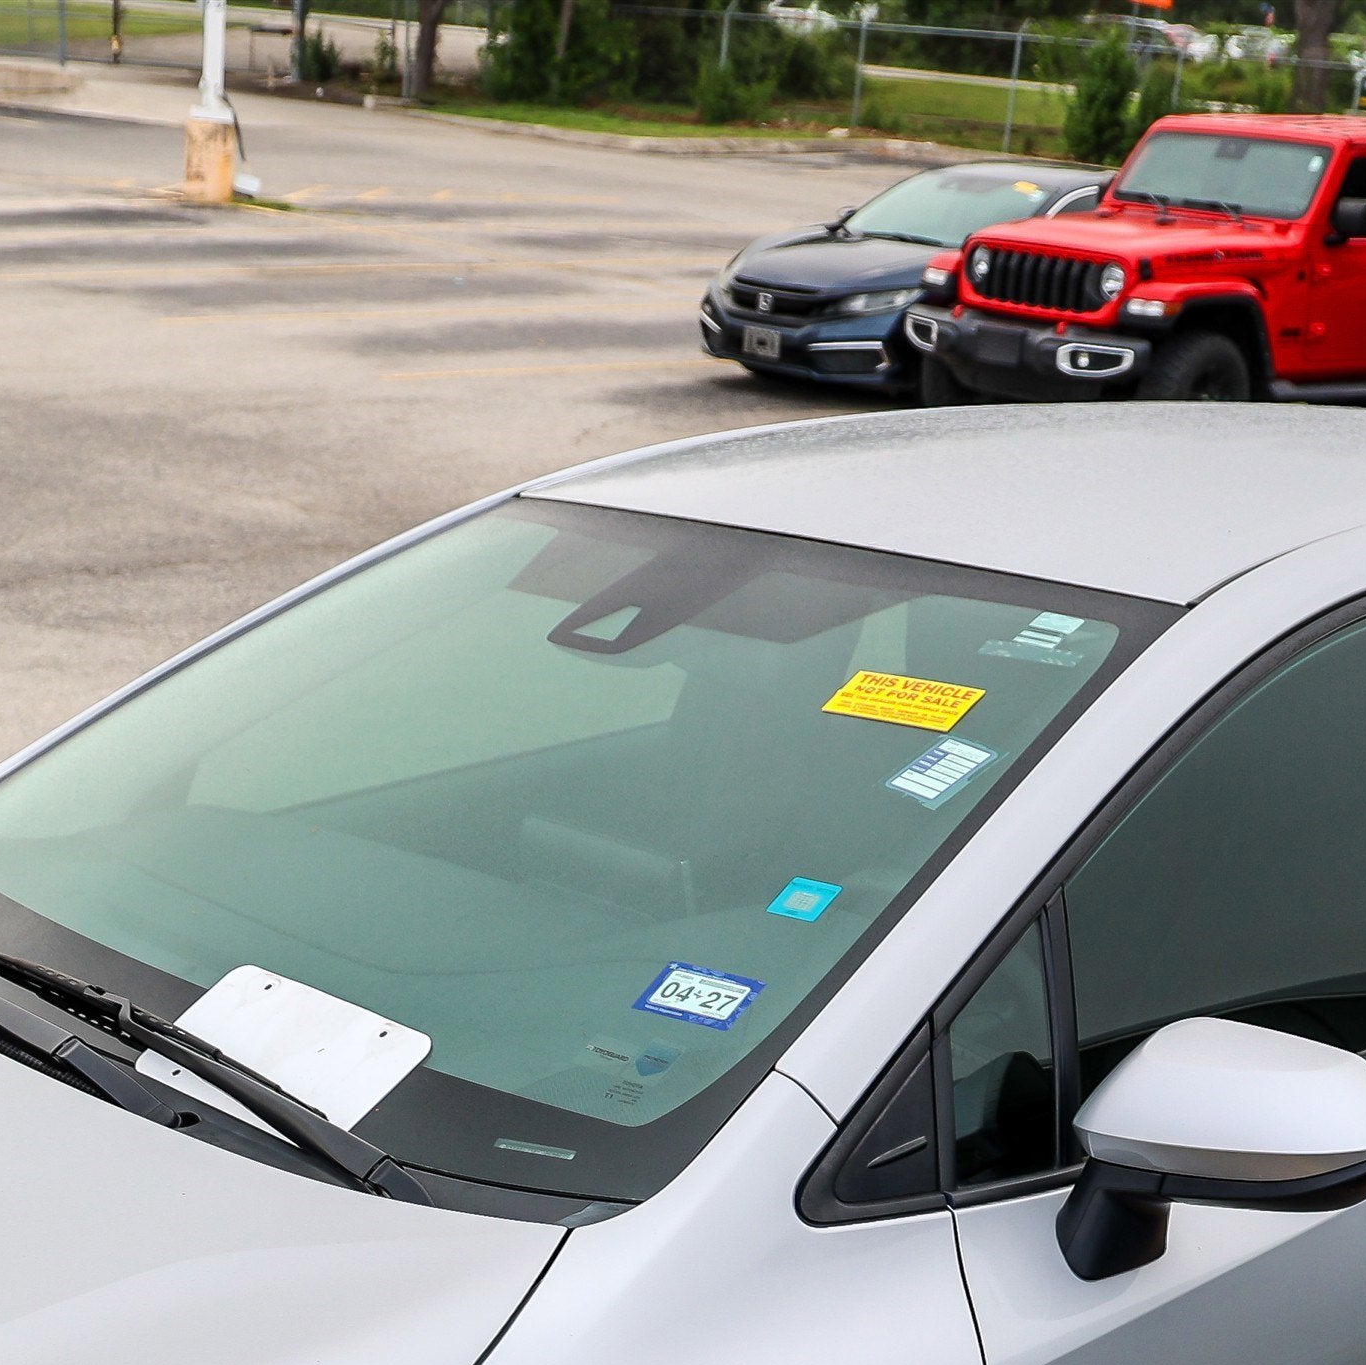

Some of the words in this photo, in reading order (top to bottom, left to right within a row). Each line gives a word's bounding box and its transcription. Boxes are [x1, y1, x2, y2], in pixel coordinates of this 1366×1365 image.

[854, 685, 887, 695] NOT
[886, 689, 918, 701] FOR
[920, 695, 963, 709] SALE
[860, 674, 899, 687] THIS
[902, 680, 977, 700] VEHICLE
[660, 981, 695, 1002] 04
[698, 991, 739, 1011] 27
